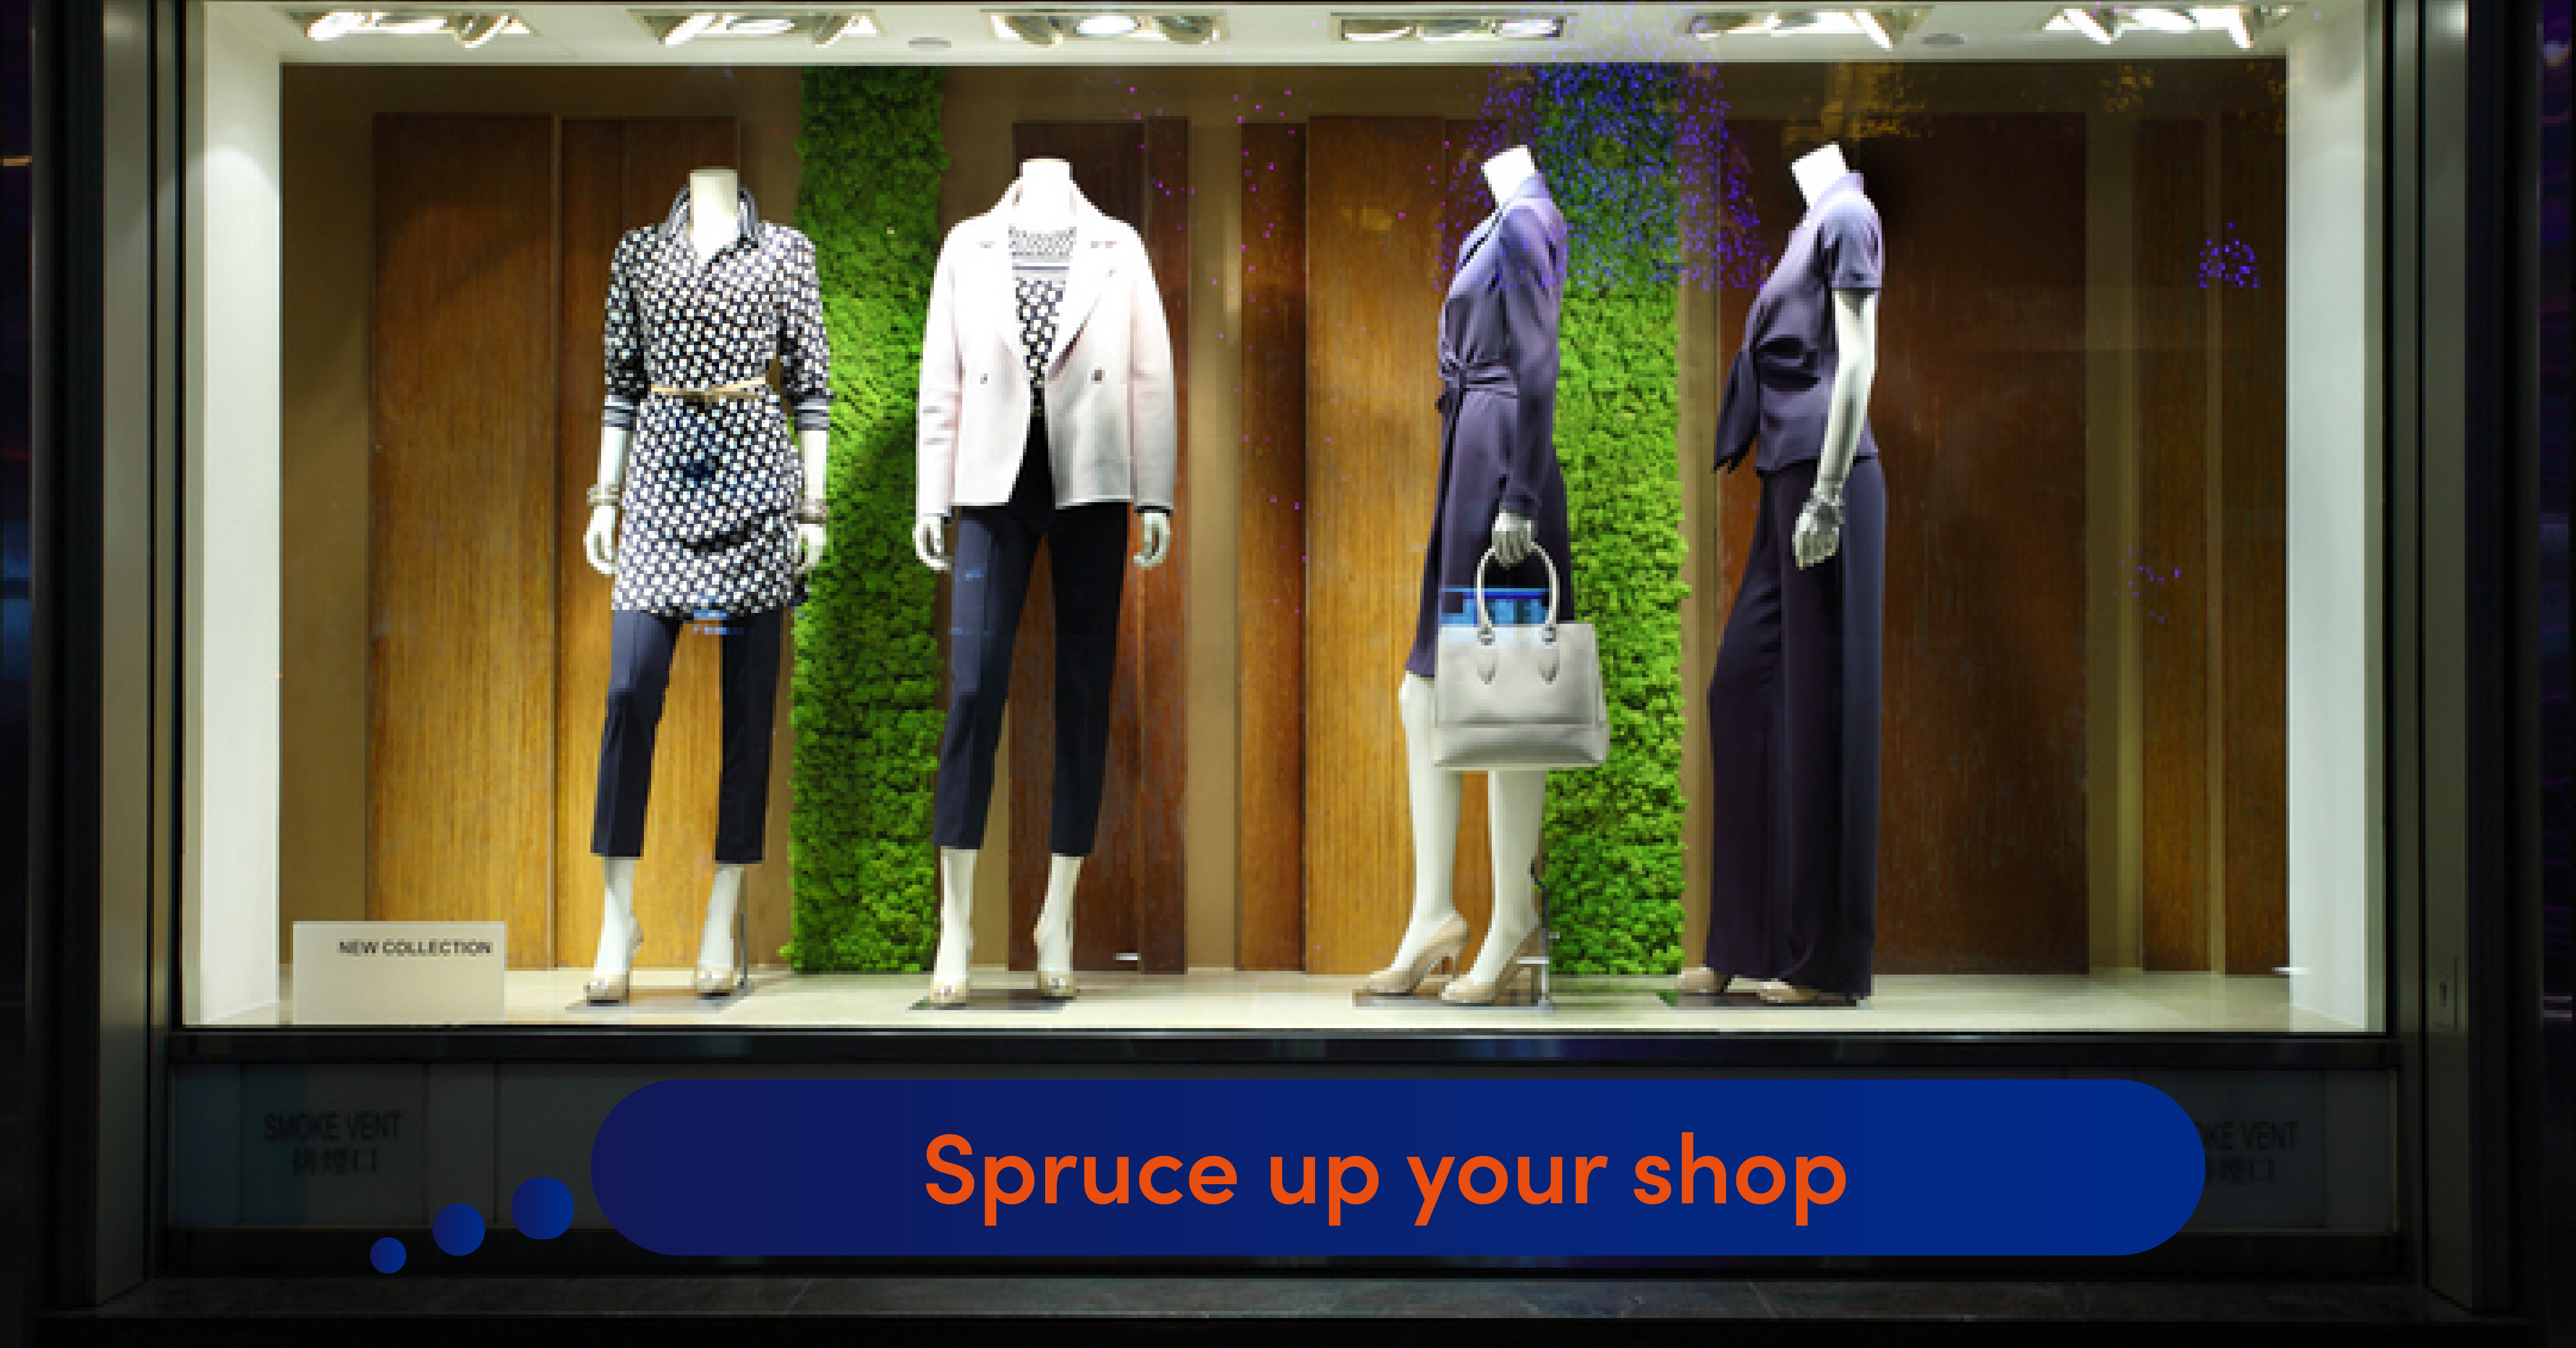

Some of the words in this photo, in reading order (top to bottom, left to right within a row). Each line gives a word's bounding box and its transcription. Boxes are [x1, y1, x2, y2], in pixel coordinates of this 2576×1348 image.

[338, 939, 378, 957] NEW
[382, 939, 493, 957] COLLECTION
[264, 1111, 339, 1142] SMOKE
[346, 1110, 401, 1140] VENT
[2242, 1120, 2300, 1150] VENT
